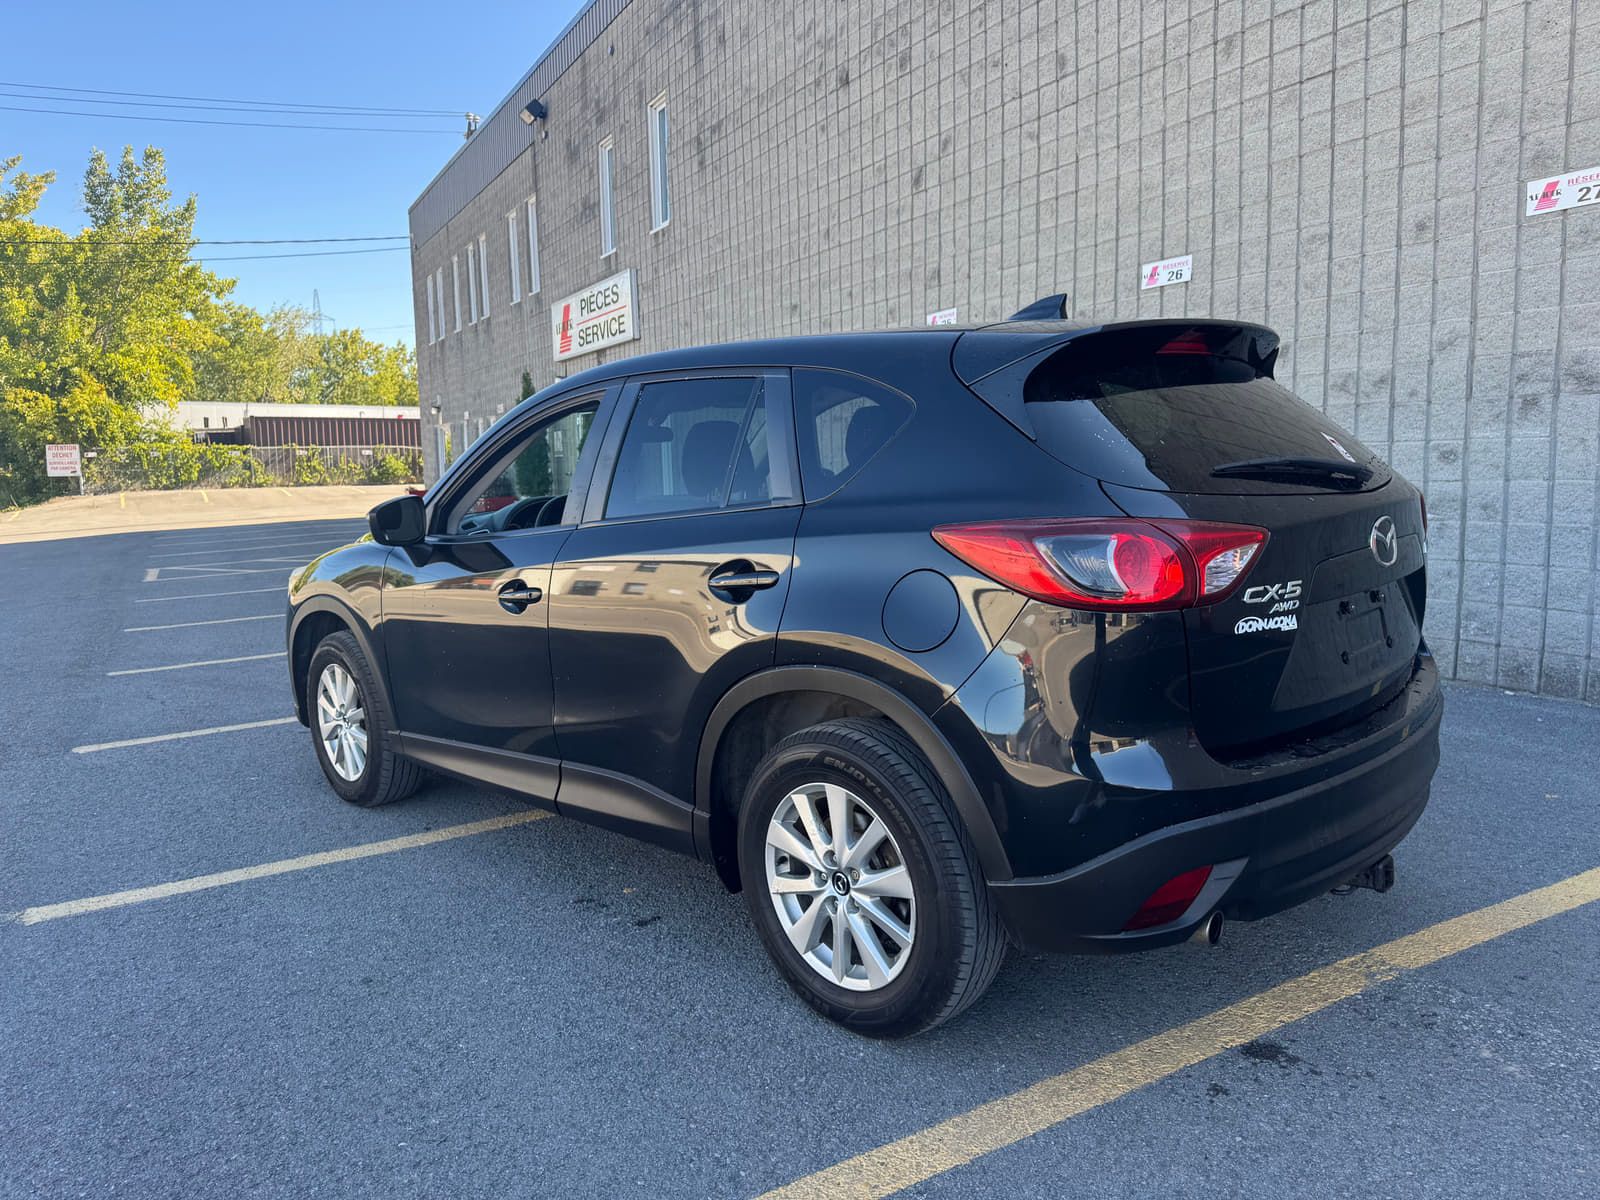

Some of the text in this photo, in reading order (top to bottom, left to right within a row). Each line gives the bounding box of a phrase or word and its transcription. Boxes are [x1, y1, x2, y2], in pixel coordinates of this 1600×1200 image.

[1168, 269, 1183, 282] 26
[578, 314, 626, 347] SERVICE
[1243, 580, 1303, 604] CX-5
[1268, 600, 1300, 615] AWD
